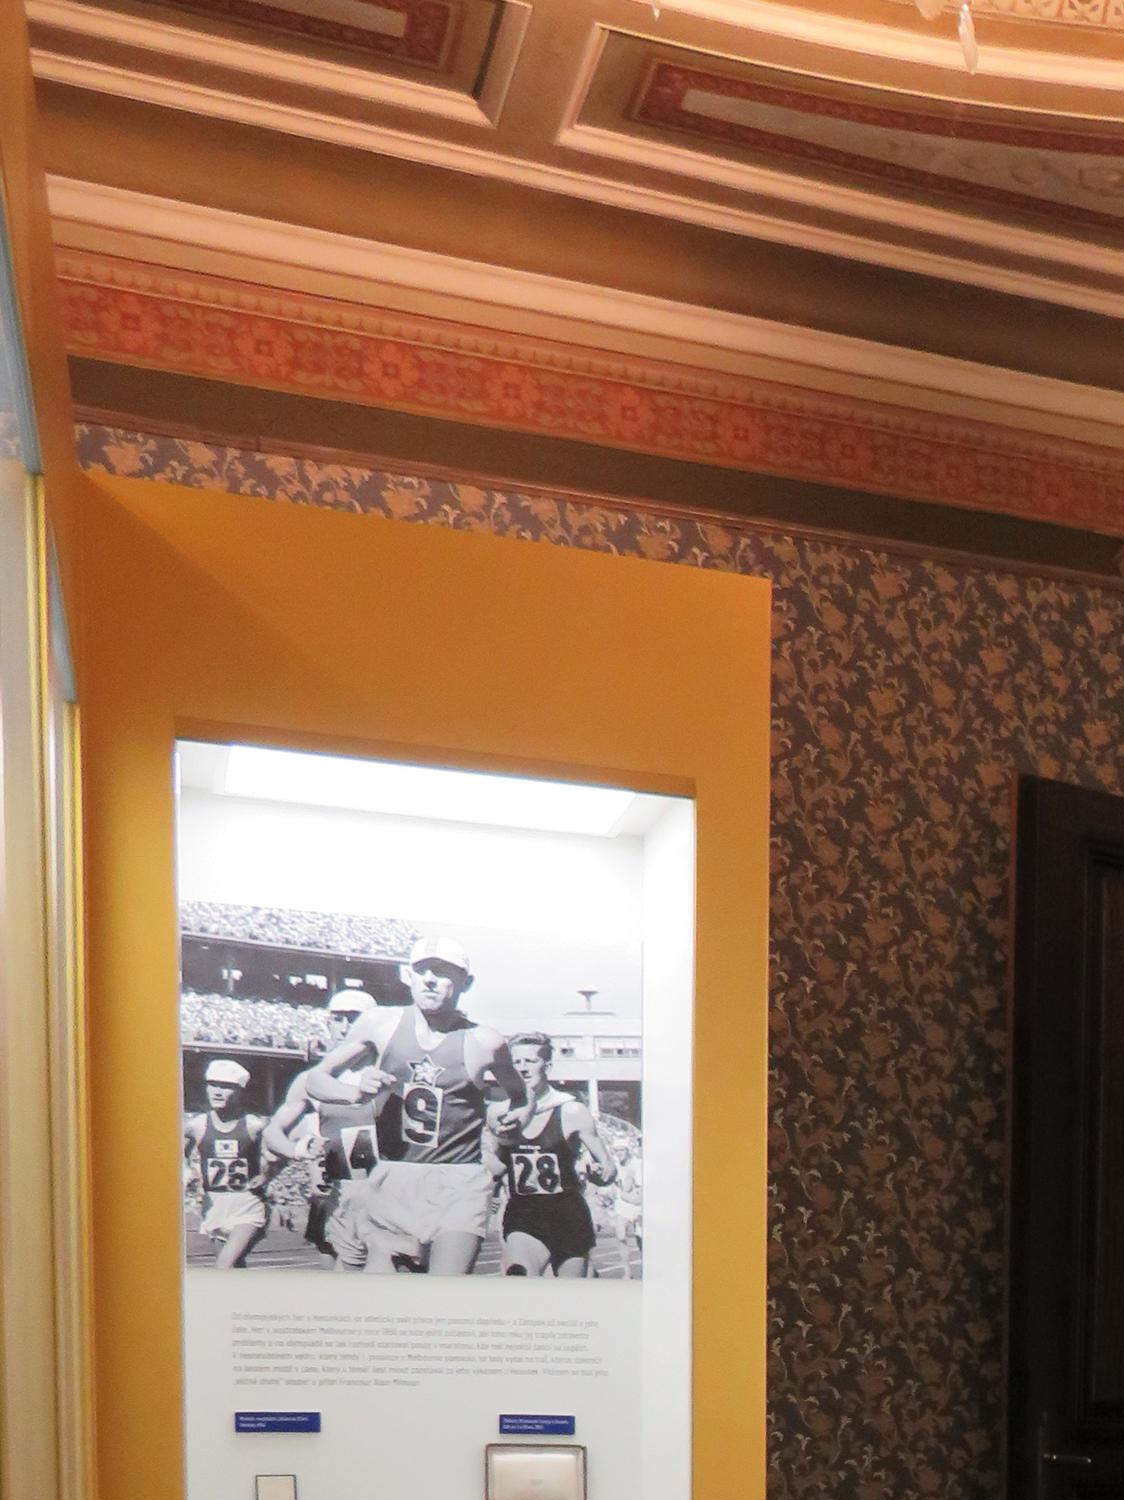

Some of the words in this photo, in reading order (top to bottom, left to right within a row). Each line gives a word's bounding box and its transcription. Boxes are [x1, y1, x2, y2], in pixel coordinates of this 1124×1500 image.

[404, 1087, 439, 1144] 9
[208, 1160, 247, 1191] 26
[515, 1155, 559, 1193] 28
